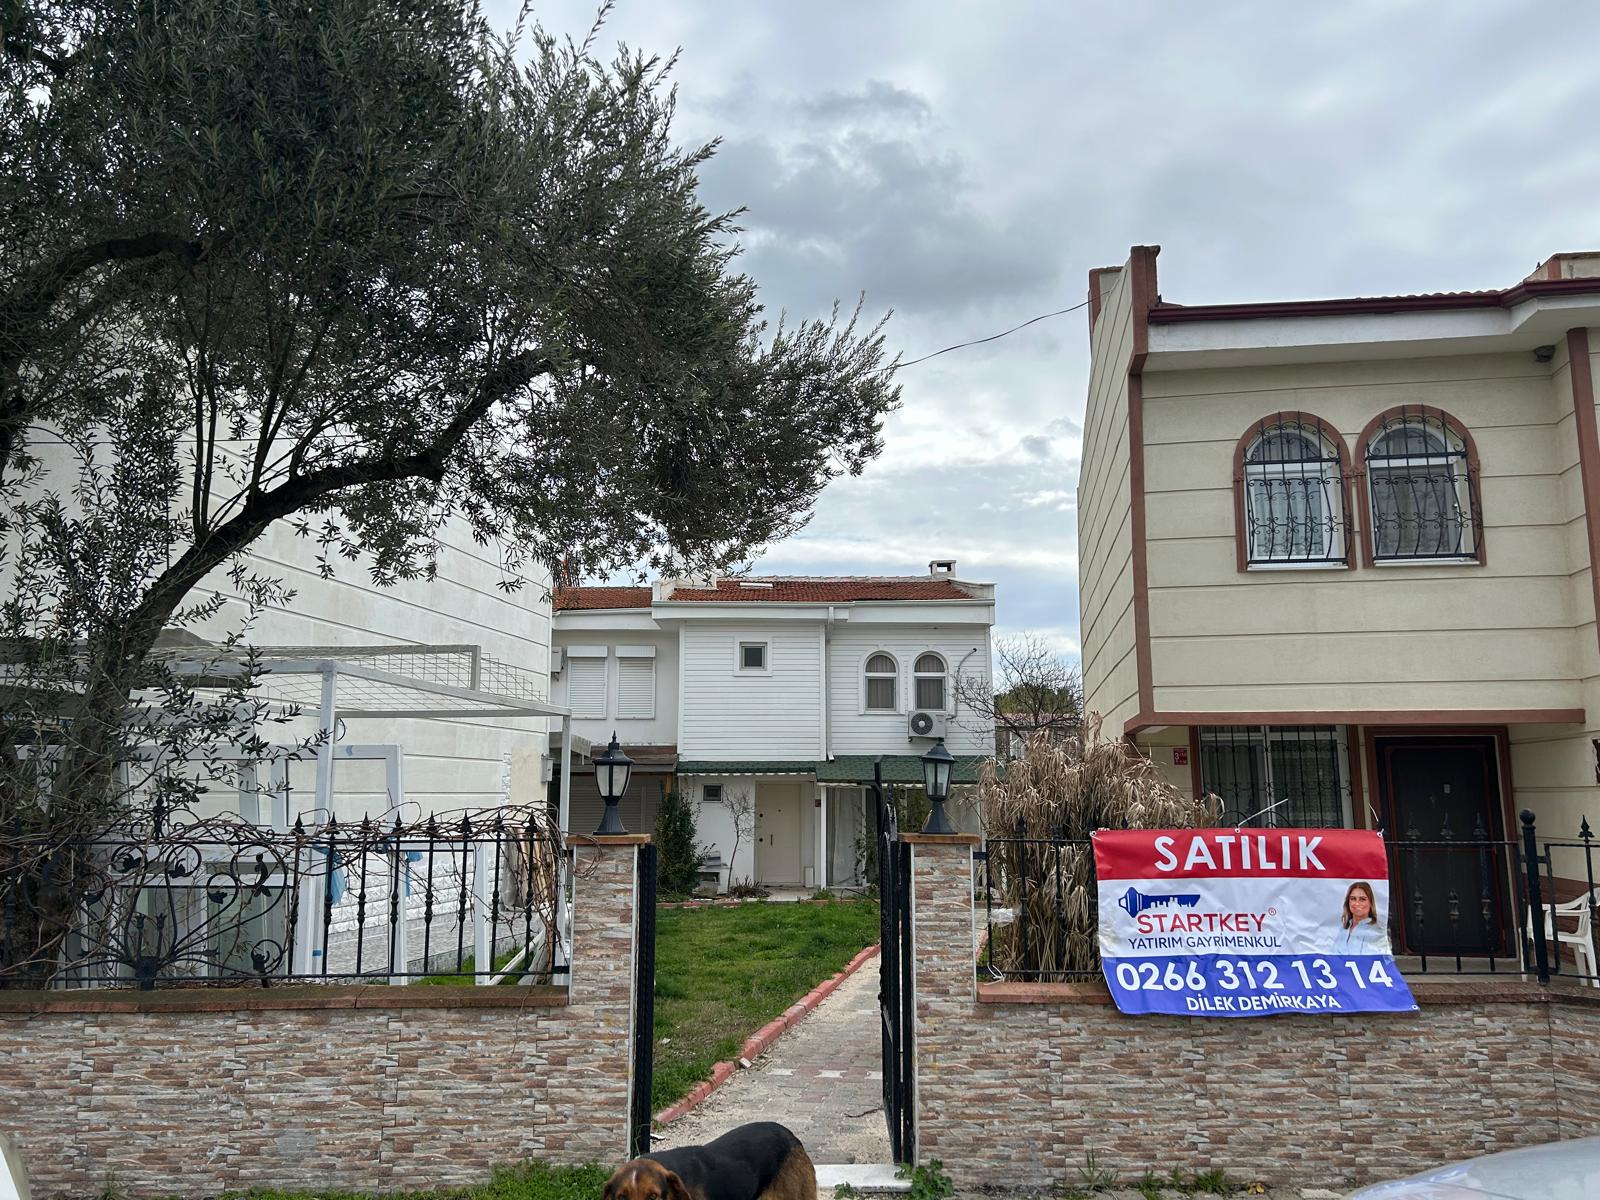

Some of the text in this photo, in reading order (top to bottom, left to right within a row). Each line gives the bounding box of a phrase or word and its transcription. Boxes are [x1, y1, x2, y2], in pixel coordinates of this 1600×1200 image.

[1154, 835, 1326, 872] SATILIK
[1137, 913, 1266, 934] STARTKEY
[1128, 933, 1282, 950] YATIRIM GAYRİMENKUL
[1116, 958, 1393, 991] 0266 312 13 14
[1186, 991, 1342, 1011] DİLEK DEMİRKAYA
